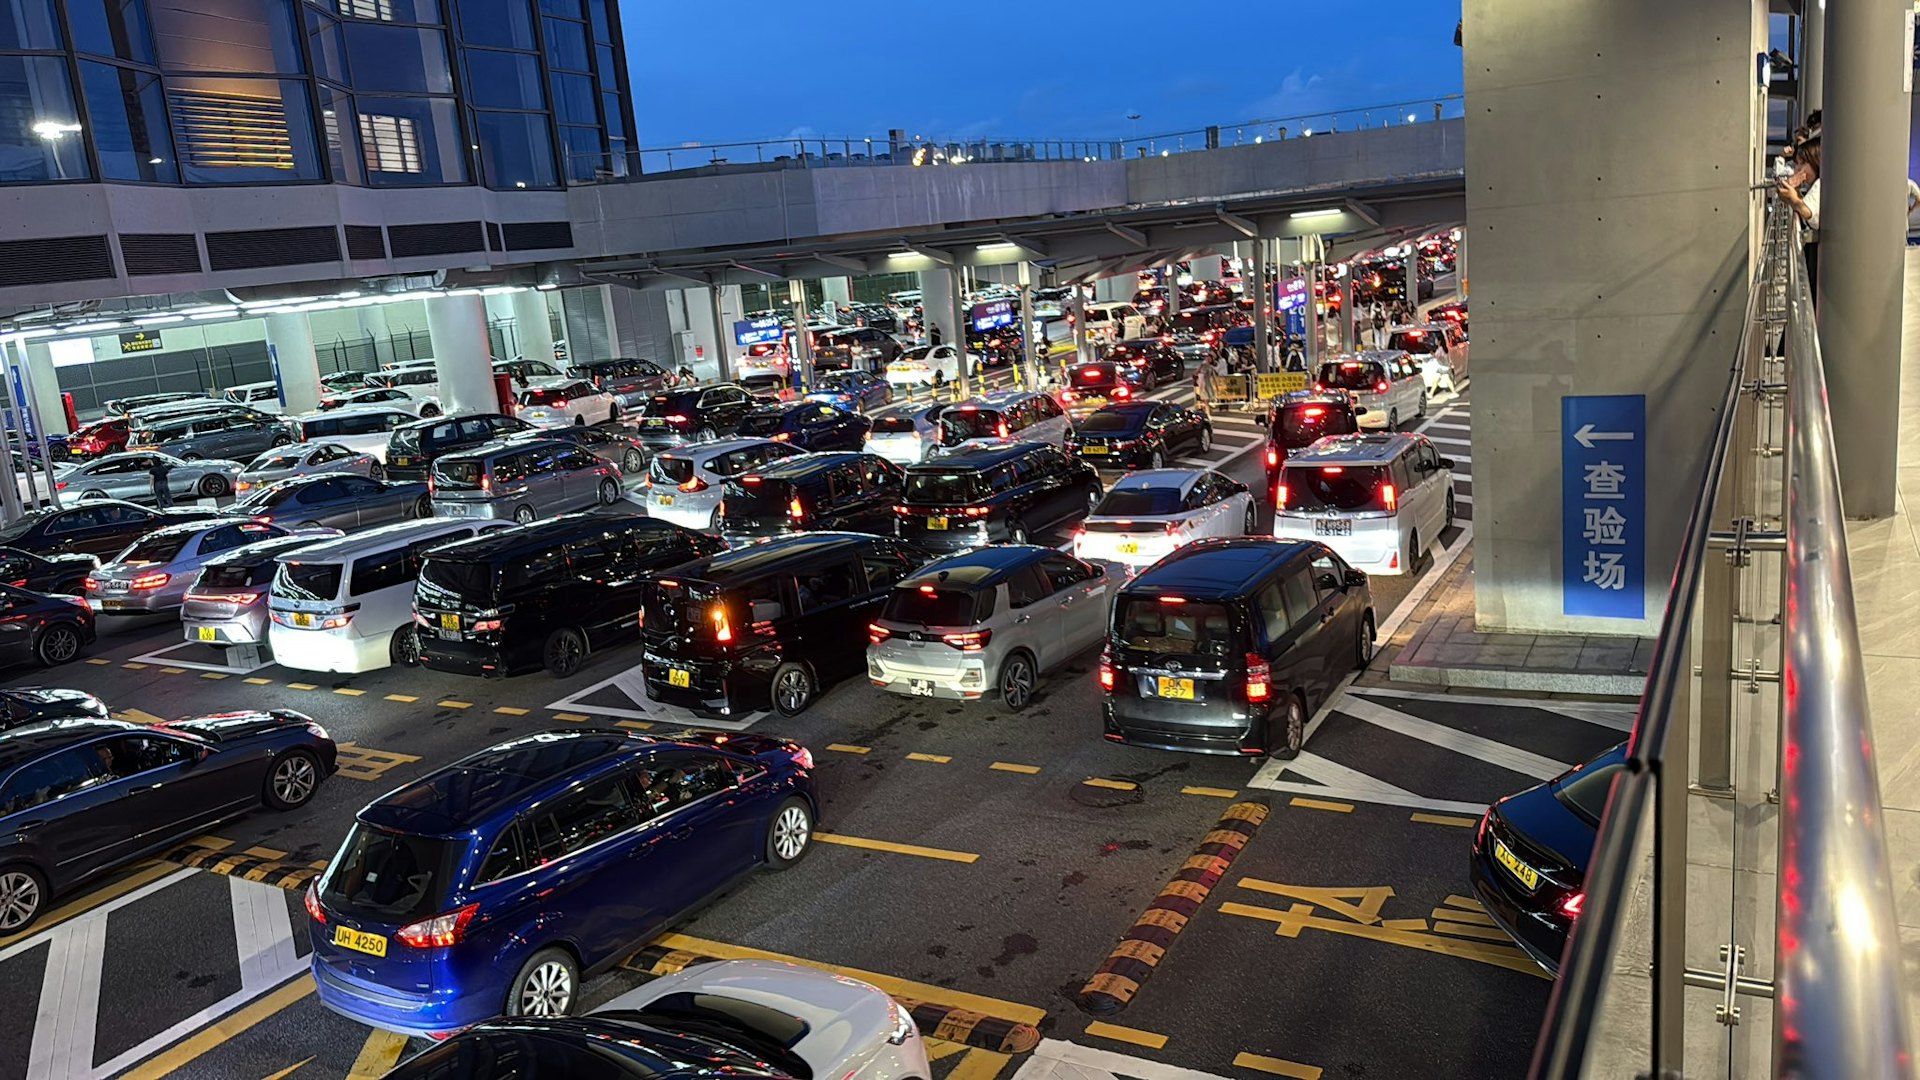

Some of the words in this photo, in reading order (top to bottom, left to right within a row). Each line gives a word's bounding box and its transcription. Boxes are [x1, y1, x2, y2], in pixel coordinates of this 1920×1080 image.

[1583, 461, 1626, 590] 查验场
[1163, 687, 1186, 696] 237
[337, 929, 351, 945] UH
[355, 935, 383, 952] 4250
